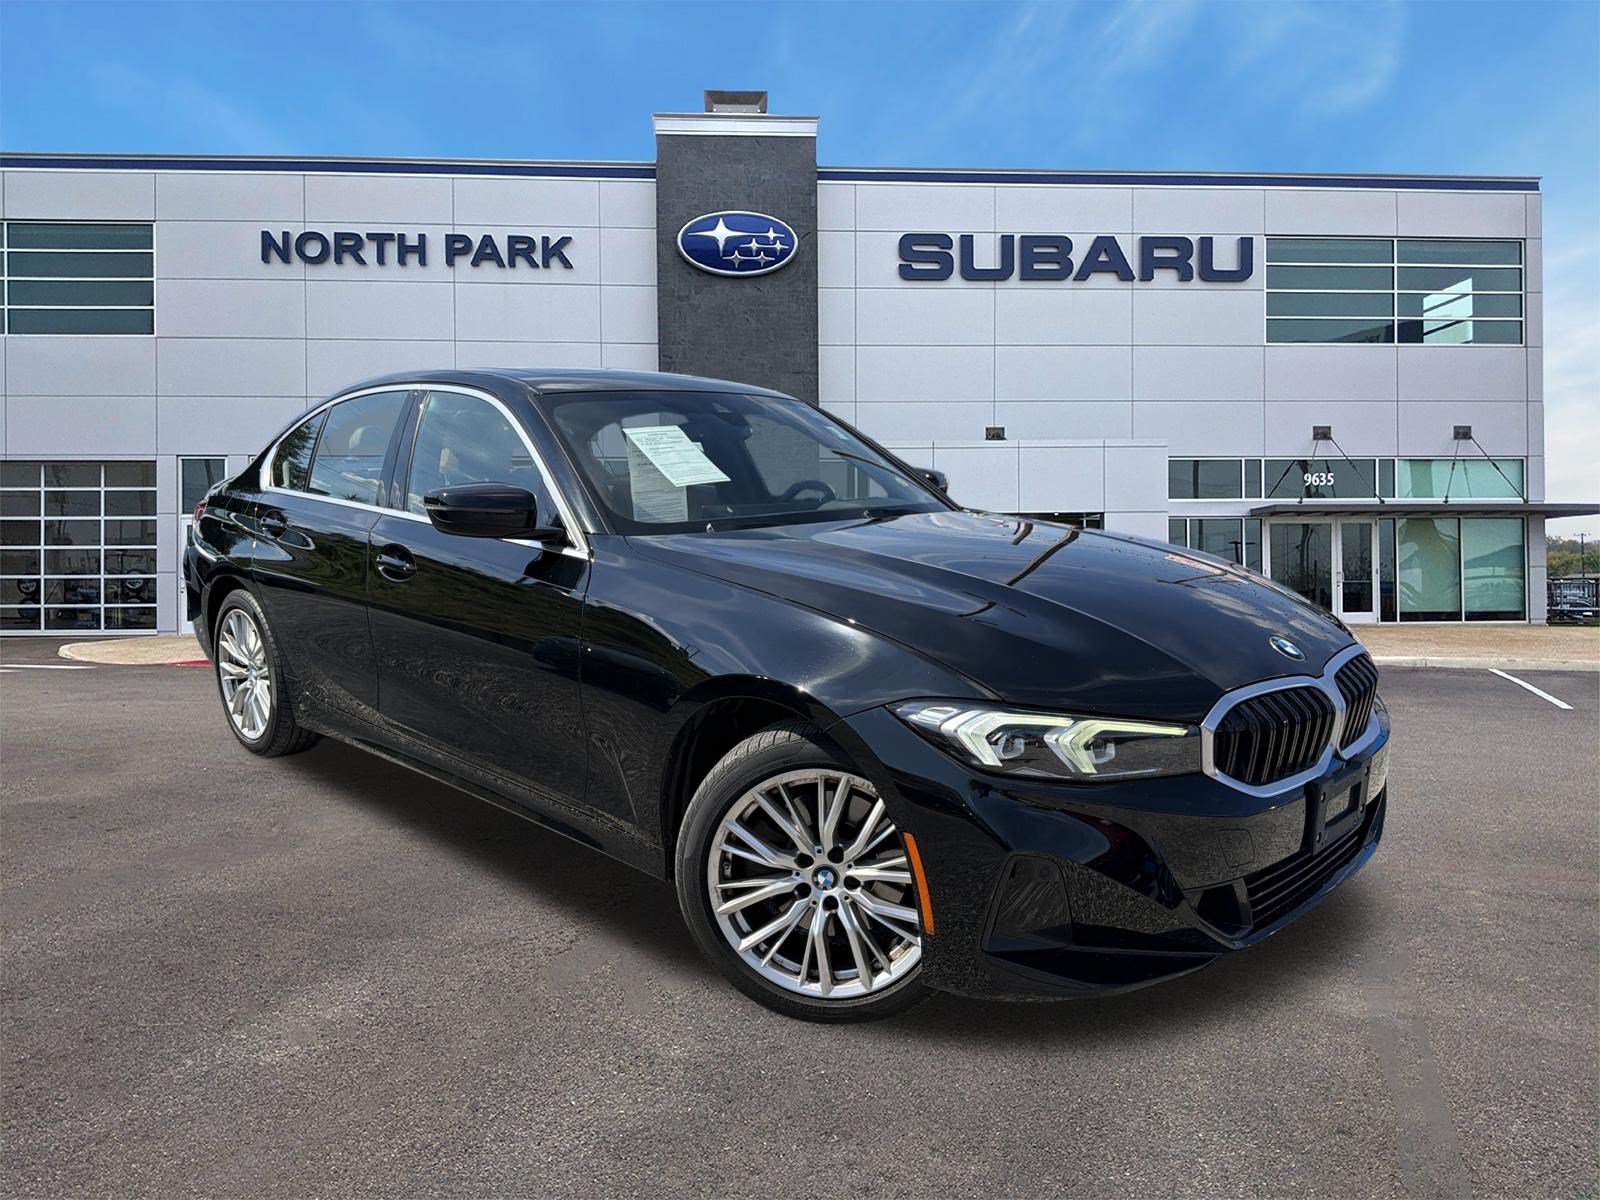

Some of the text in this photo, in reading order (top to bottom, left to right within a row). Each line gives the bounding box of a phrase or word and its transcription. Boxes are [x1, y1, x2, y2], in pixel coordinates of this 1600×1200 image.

[261, 230, 574, 269] NORTH PARK
[898, 233, 1254, 282] SUBARU
[1304, 472, 1334, 486] 9635
